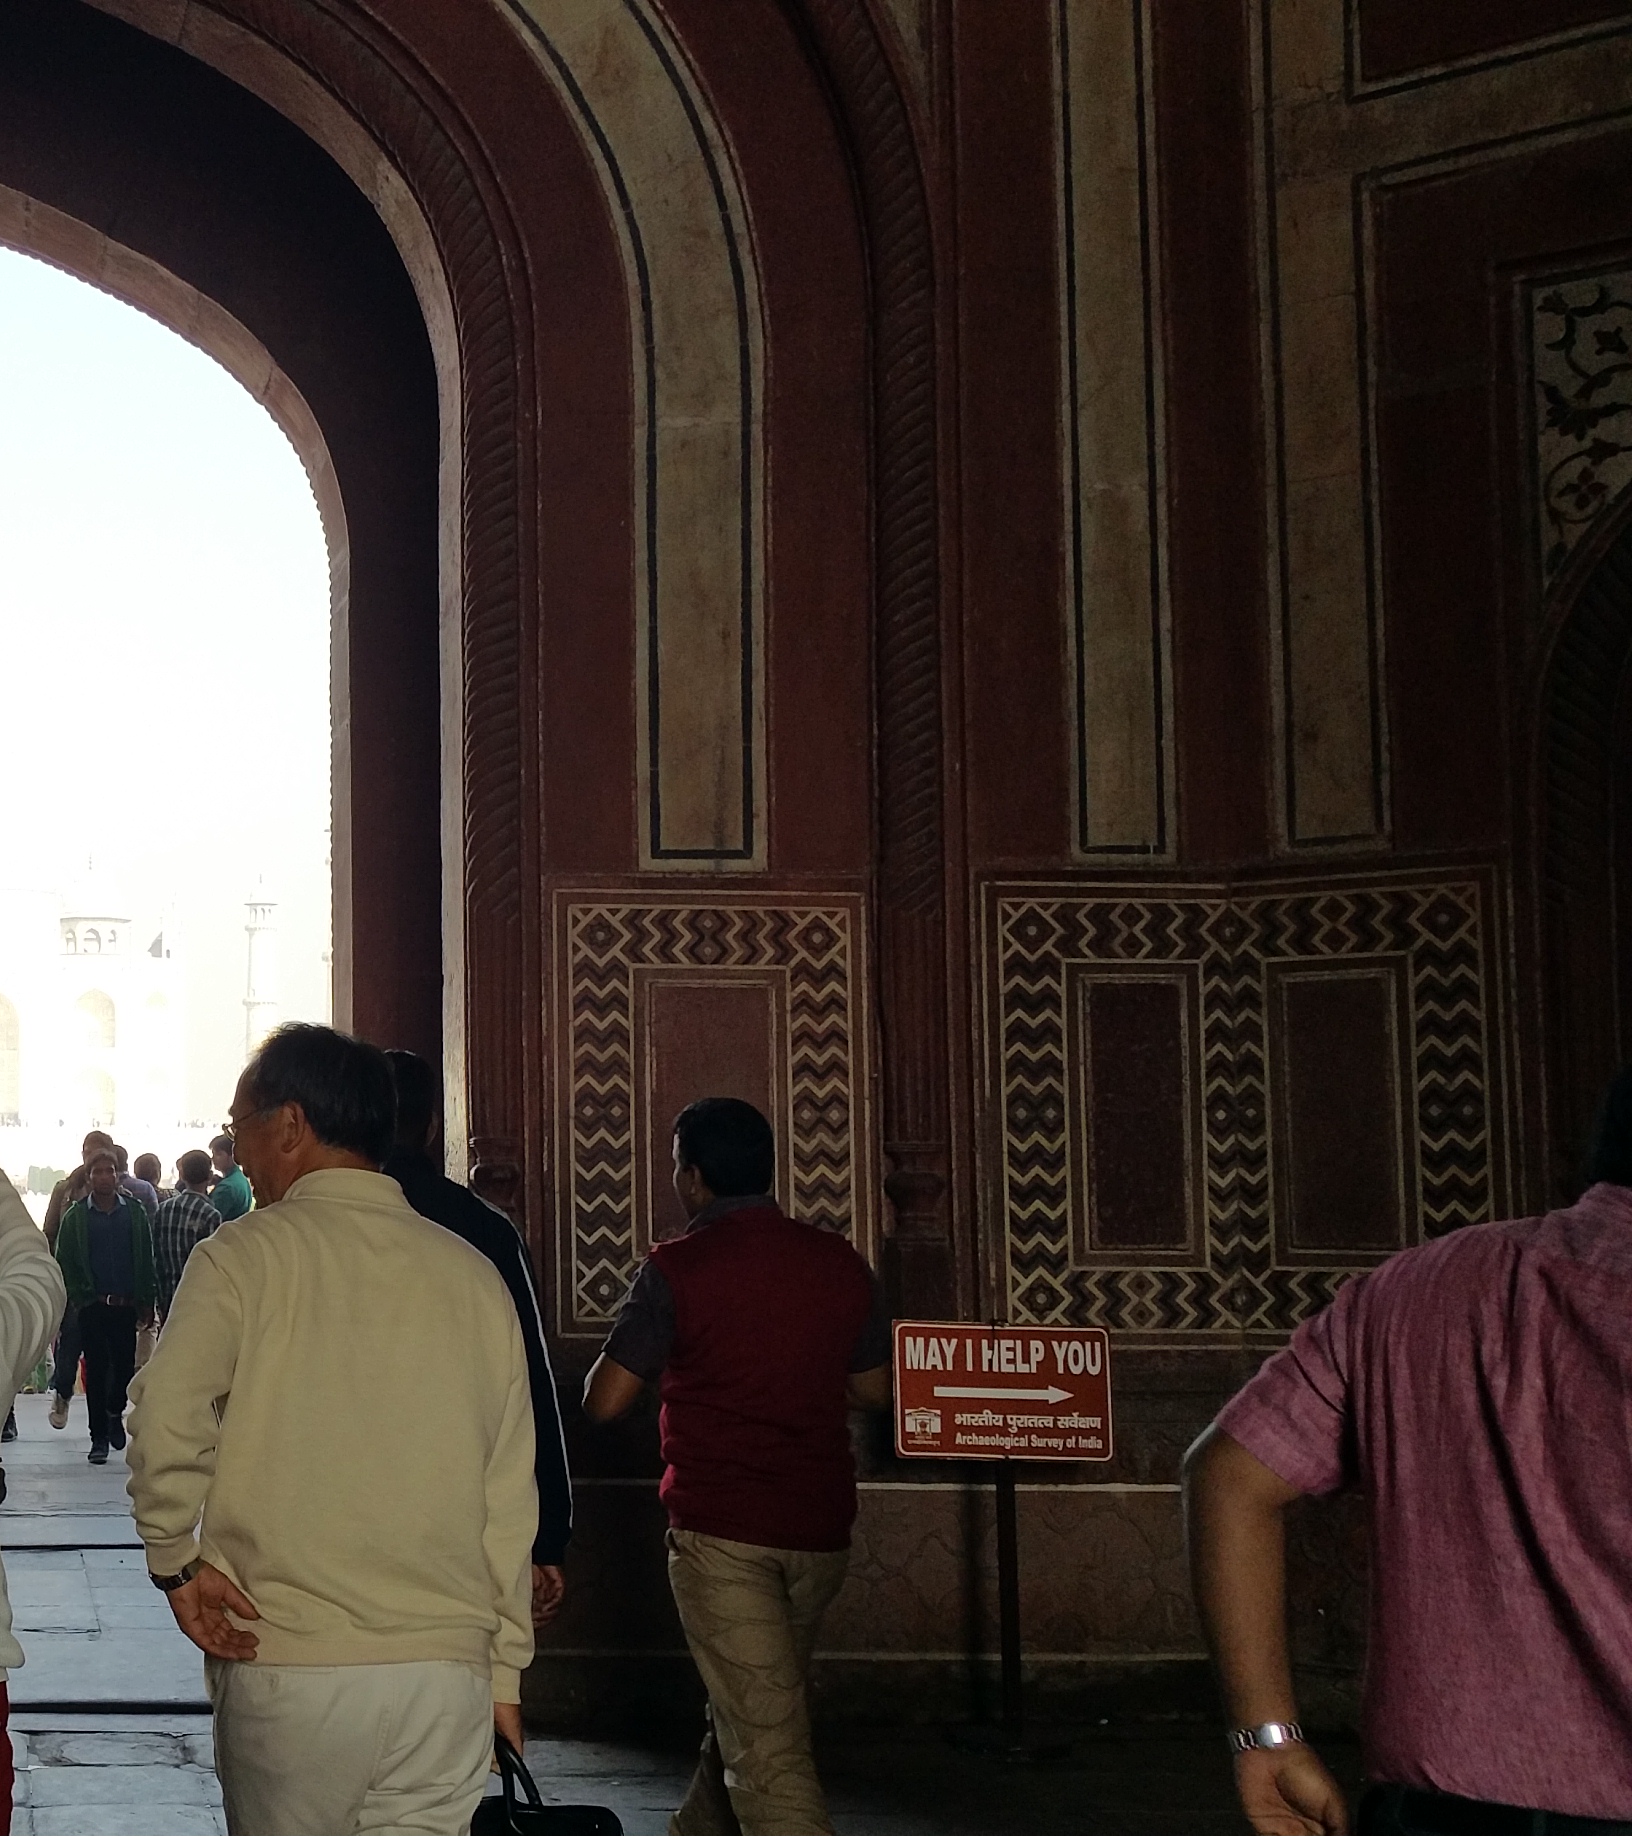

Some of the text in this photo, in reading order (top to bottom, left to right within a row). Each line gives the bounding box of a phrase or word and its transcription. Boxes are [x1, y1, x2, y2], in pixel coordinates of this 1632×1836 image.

[905, 1336, 1102, 1376] MAY I HELP YOU
[954, 1409, 1102, 1433] भारतीय पुरातत्व सर्वेक्षण
[955, 1432, 1028, 1450] Archaeological
[1030, 1435, 1063, 1451] Survey
[1066, 1436, 1076, 1448] of
[1078, 1436, 1103, 1449] India
